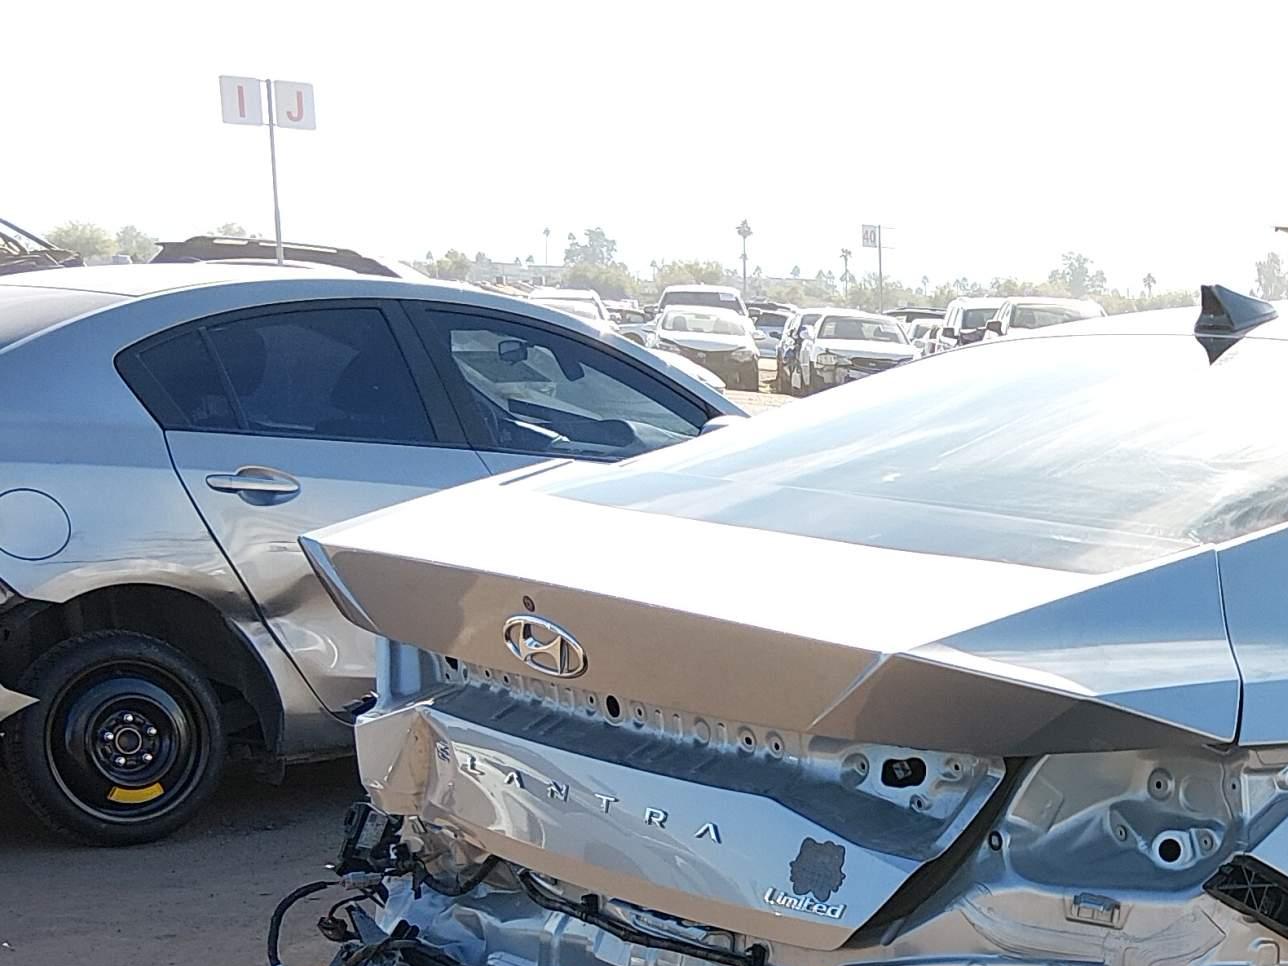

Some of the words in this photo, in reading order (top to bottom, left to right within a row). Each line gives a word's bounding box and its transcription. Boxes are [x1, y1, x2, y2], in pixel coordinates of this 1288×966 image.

[237, 85, 246, 118] I
[287, 91, 304, 122] J
[763, 887, 847, 919] Limited
